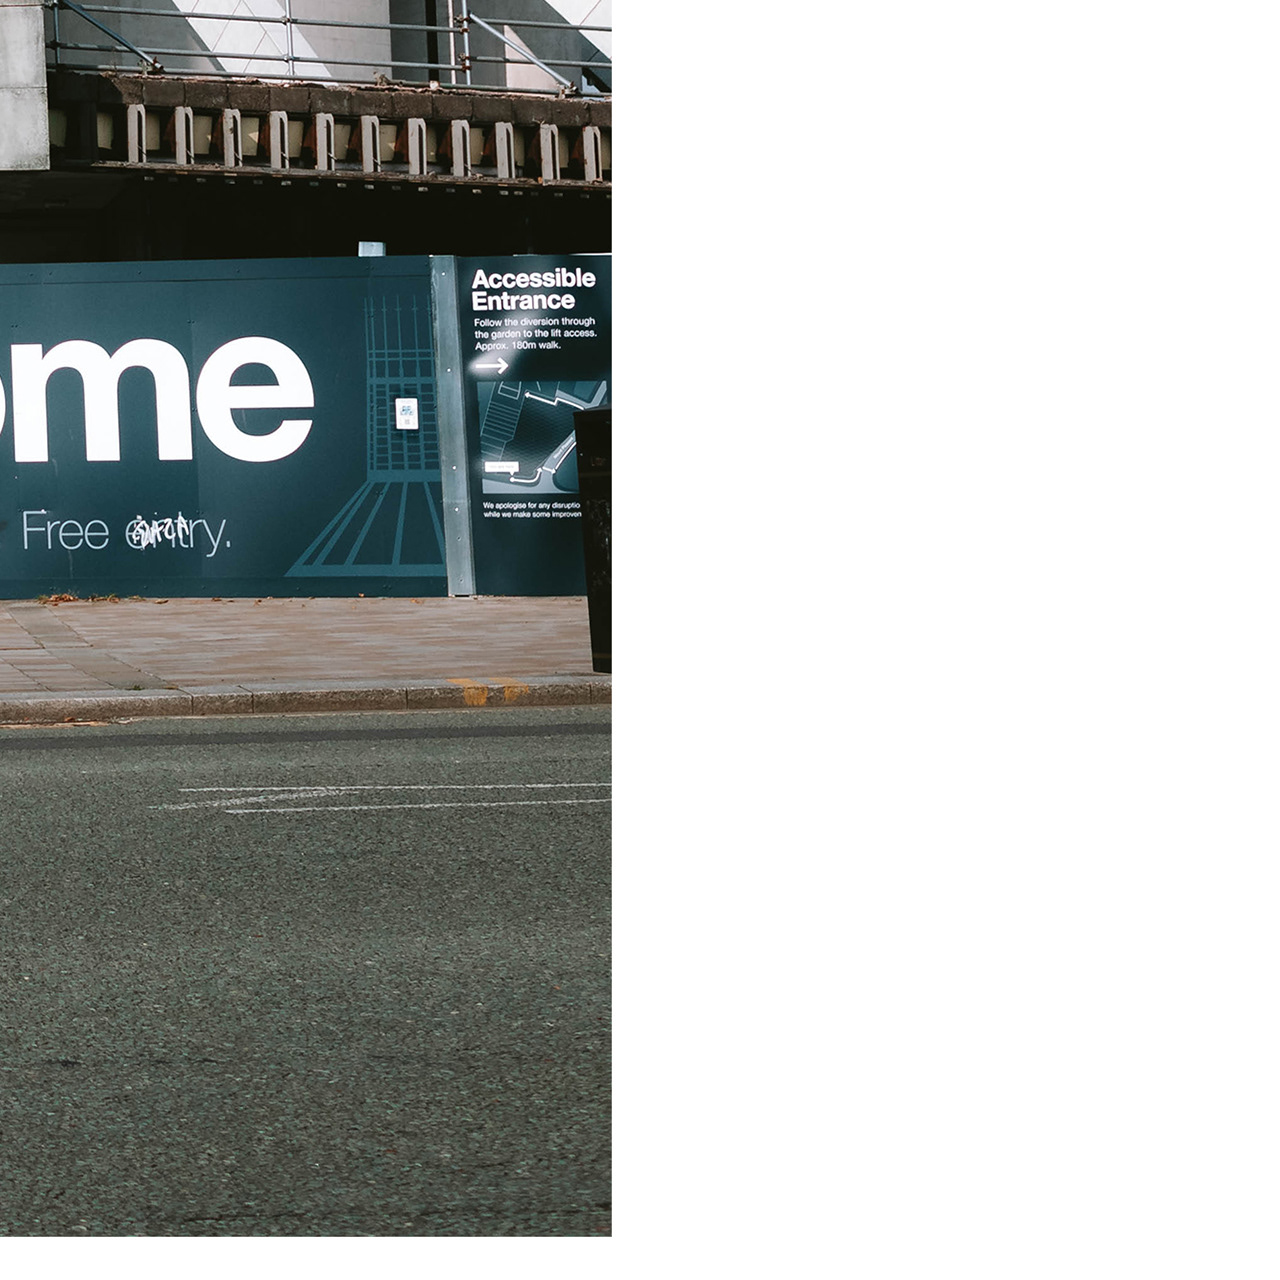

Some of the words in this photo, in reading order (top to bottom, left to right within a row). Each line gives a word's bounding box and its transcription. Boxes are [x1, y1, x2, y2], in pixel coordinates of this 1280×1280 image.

[471, 267, 596, 289] Accessible
[471, 291, 576, 311] Entrance
[474, 318, 502, 327] Follow
[504, 317, 518, 327] the
[520, 317, 559, 326] diversion
[561, 316, 596, 328] through
[474, 330, 489, 339] the
[491, 329, 521, 341] garden
[523, 330, 533, 338] to
[534, 329, 549, 338] the
[550, 328, 561, 337] lift
[563, 329, 597, 337] access.
[474, 341, 509, 352] Approx.
[512, 340, 537, 350] 180m
[538, 340, 562, 350] walk.
[482, 501, 495, 509] We
[527, 501, 537, 509] for
[538, 502, 551, 510] any
[551, 501, 581, 510] disruptio
[483, 510, 501, 518] while
[512, 510, 531, 518] make
[22, 509, 110, 550] Free
